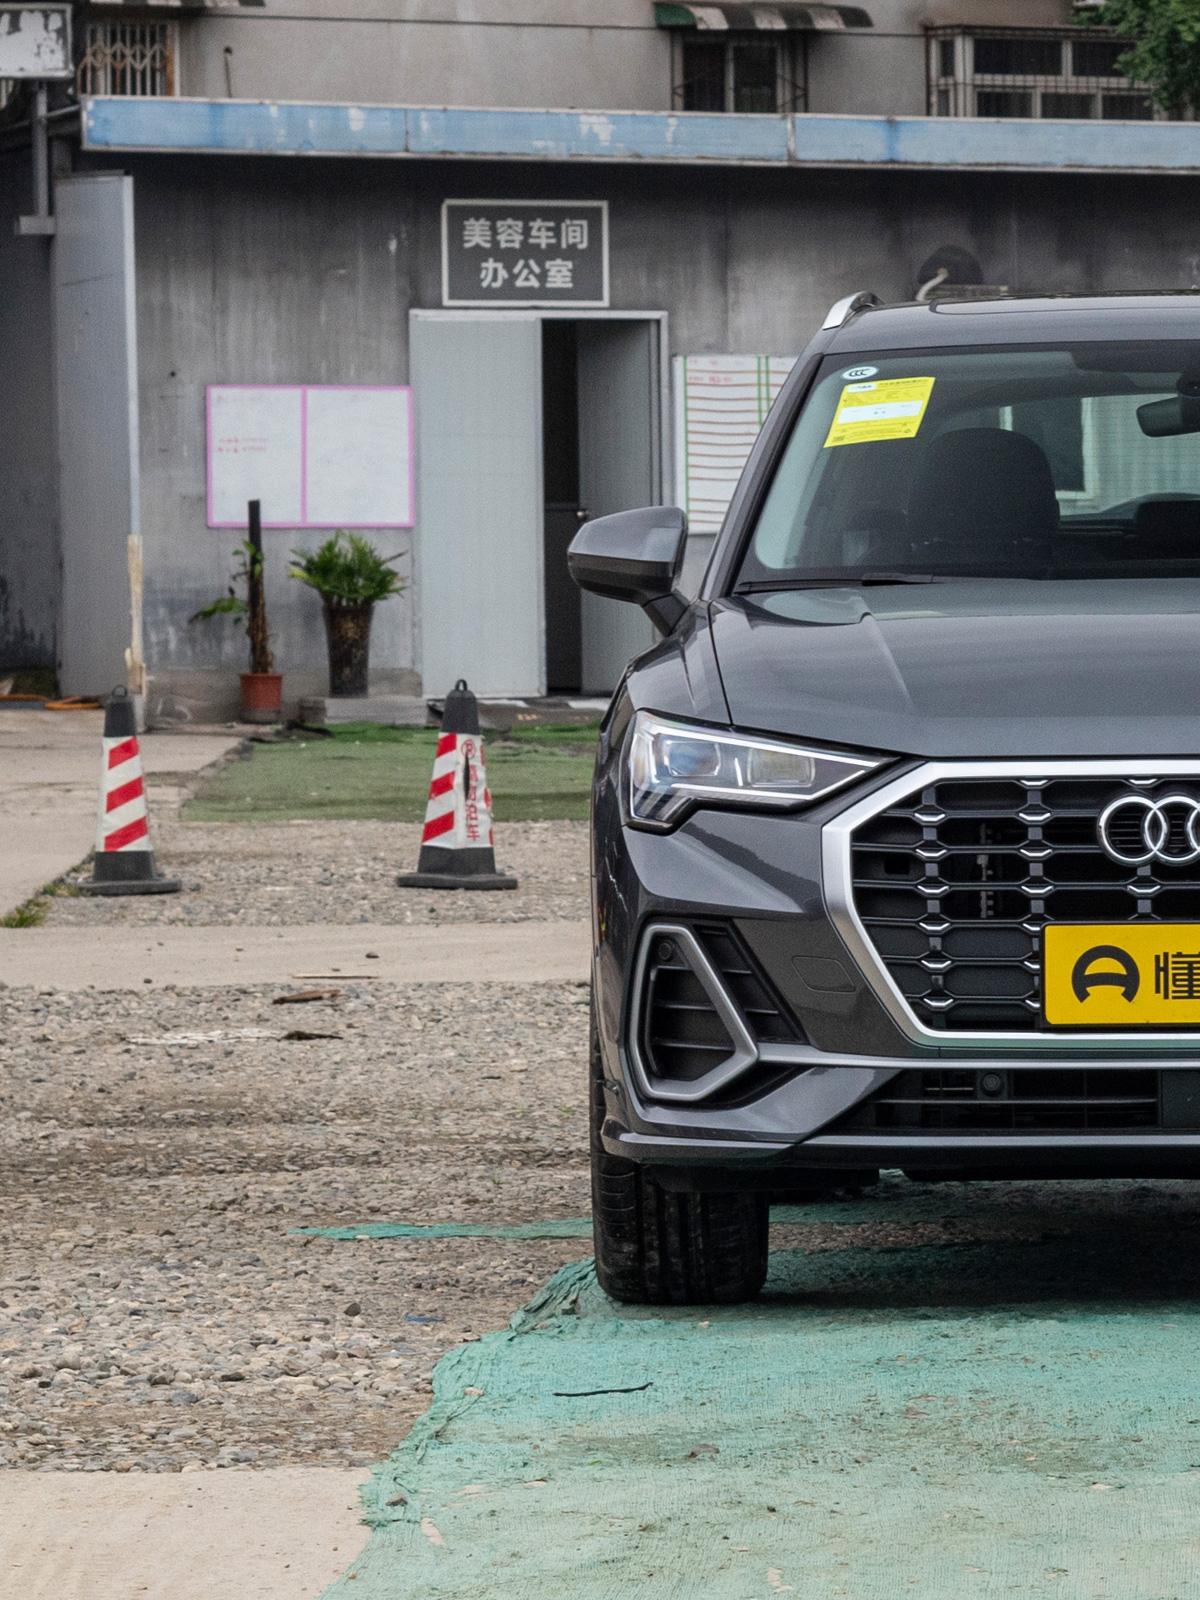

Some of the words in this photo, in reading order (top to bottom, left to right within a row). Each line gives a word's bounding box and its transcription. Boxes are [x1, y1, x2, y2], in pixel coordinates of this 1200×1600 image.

[462, 217, 589, 249] 美容车间
[479, 257, 574, 289] 办公室
